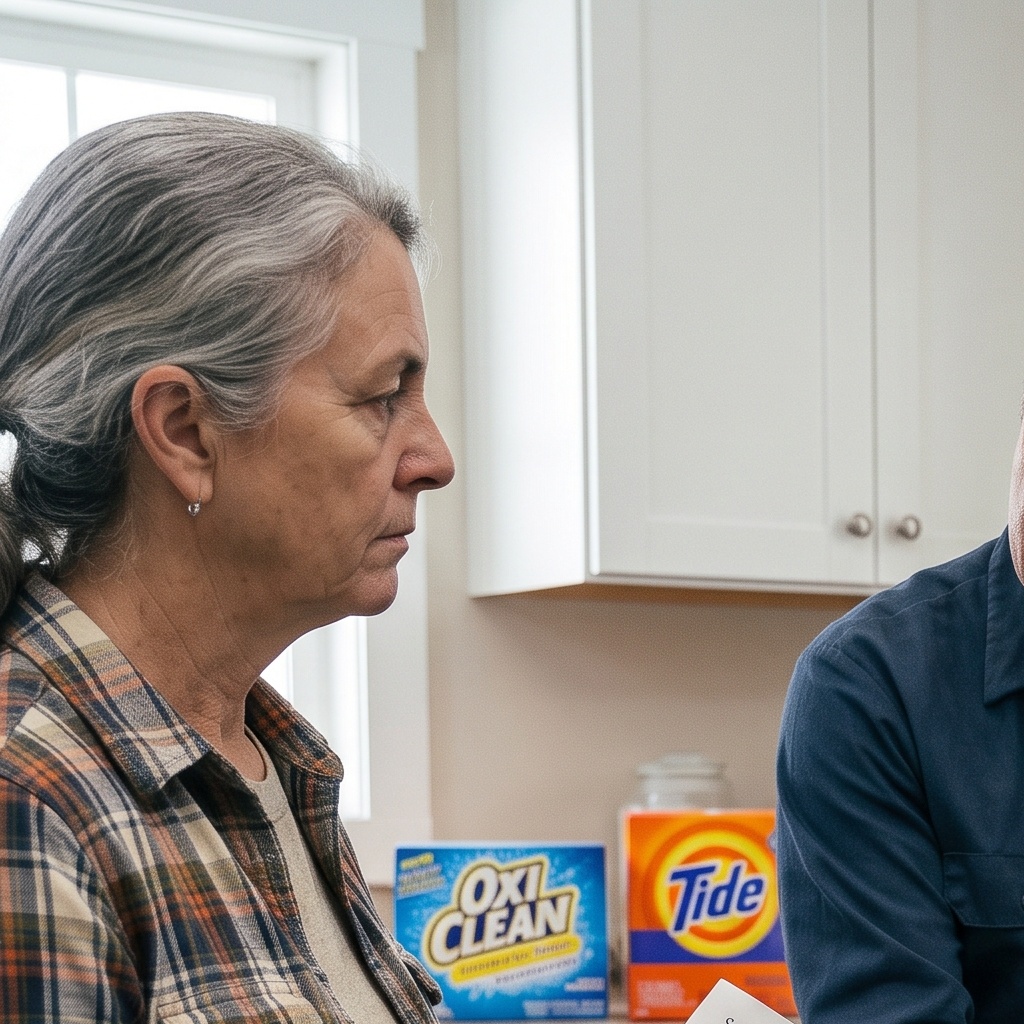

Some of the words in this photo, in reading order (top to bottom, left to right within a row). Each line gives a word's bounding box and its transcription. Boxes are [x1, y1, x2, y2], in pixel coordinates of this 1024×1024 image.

[460, 863, 542, 917] OXI
[670, 861, 764, 932] Tide
[431, 894, 571, 964] CLEAN
